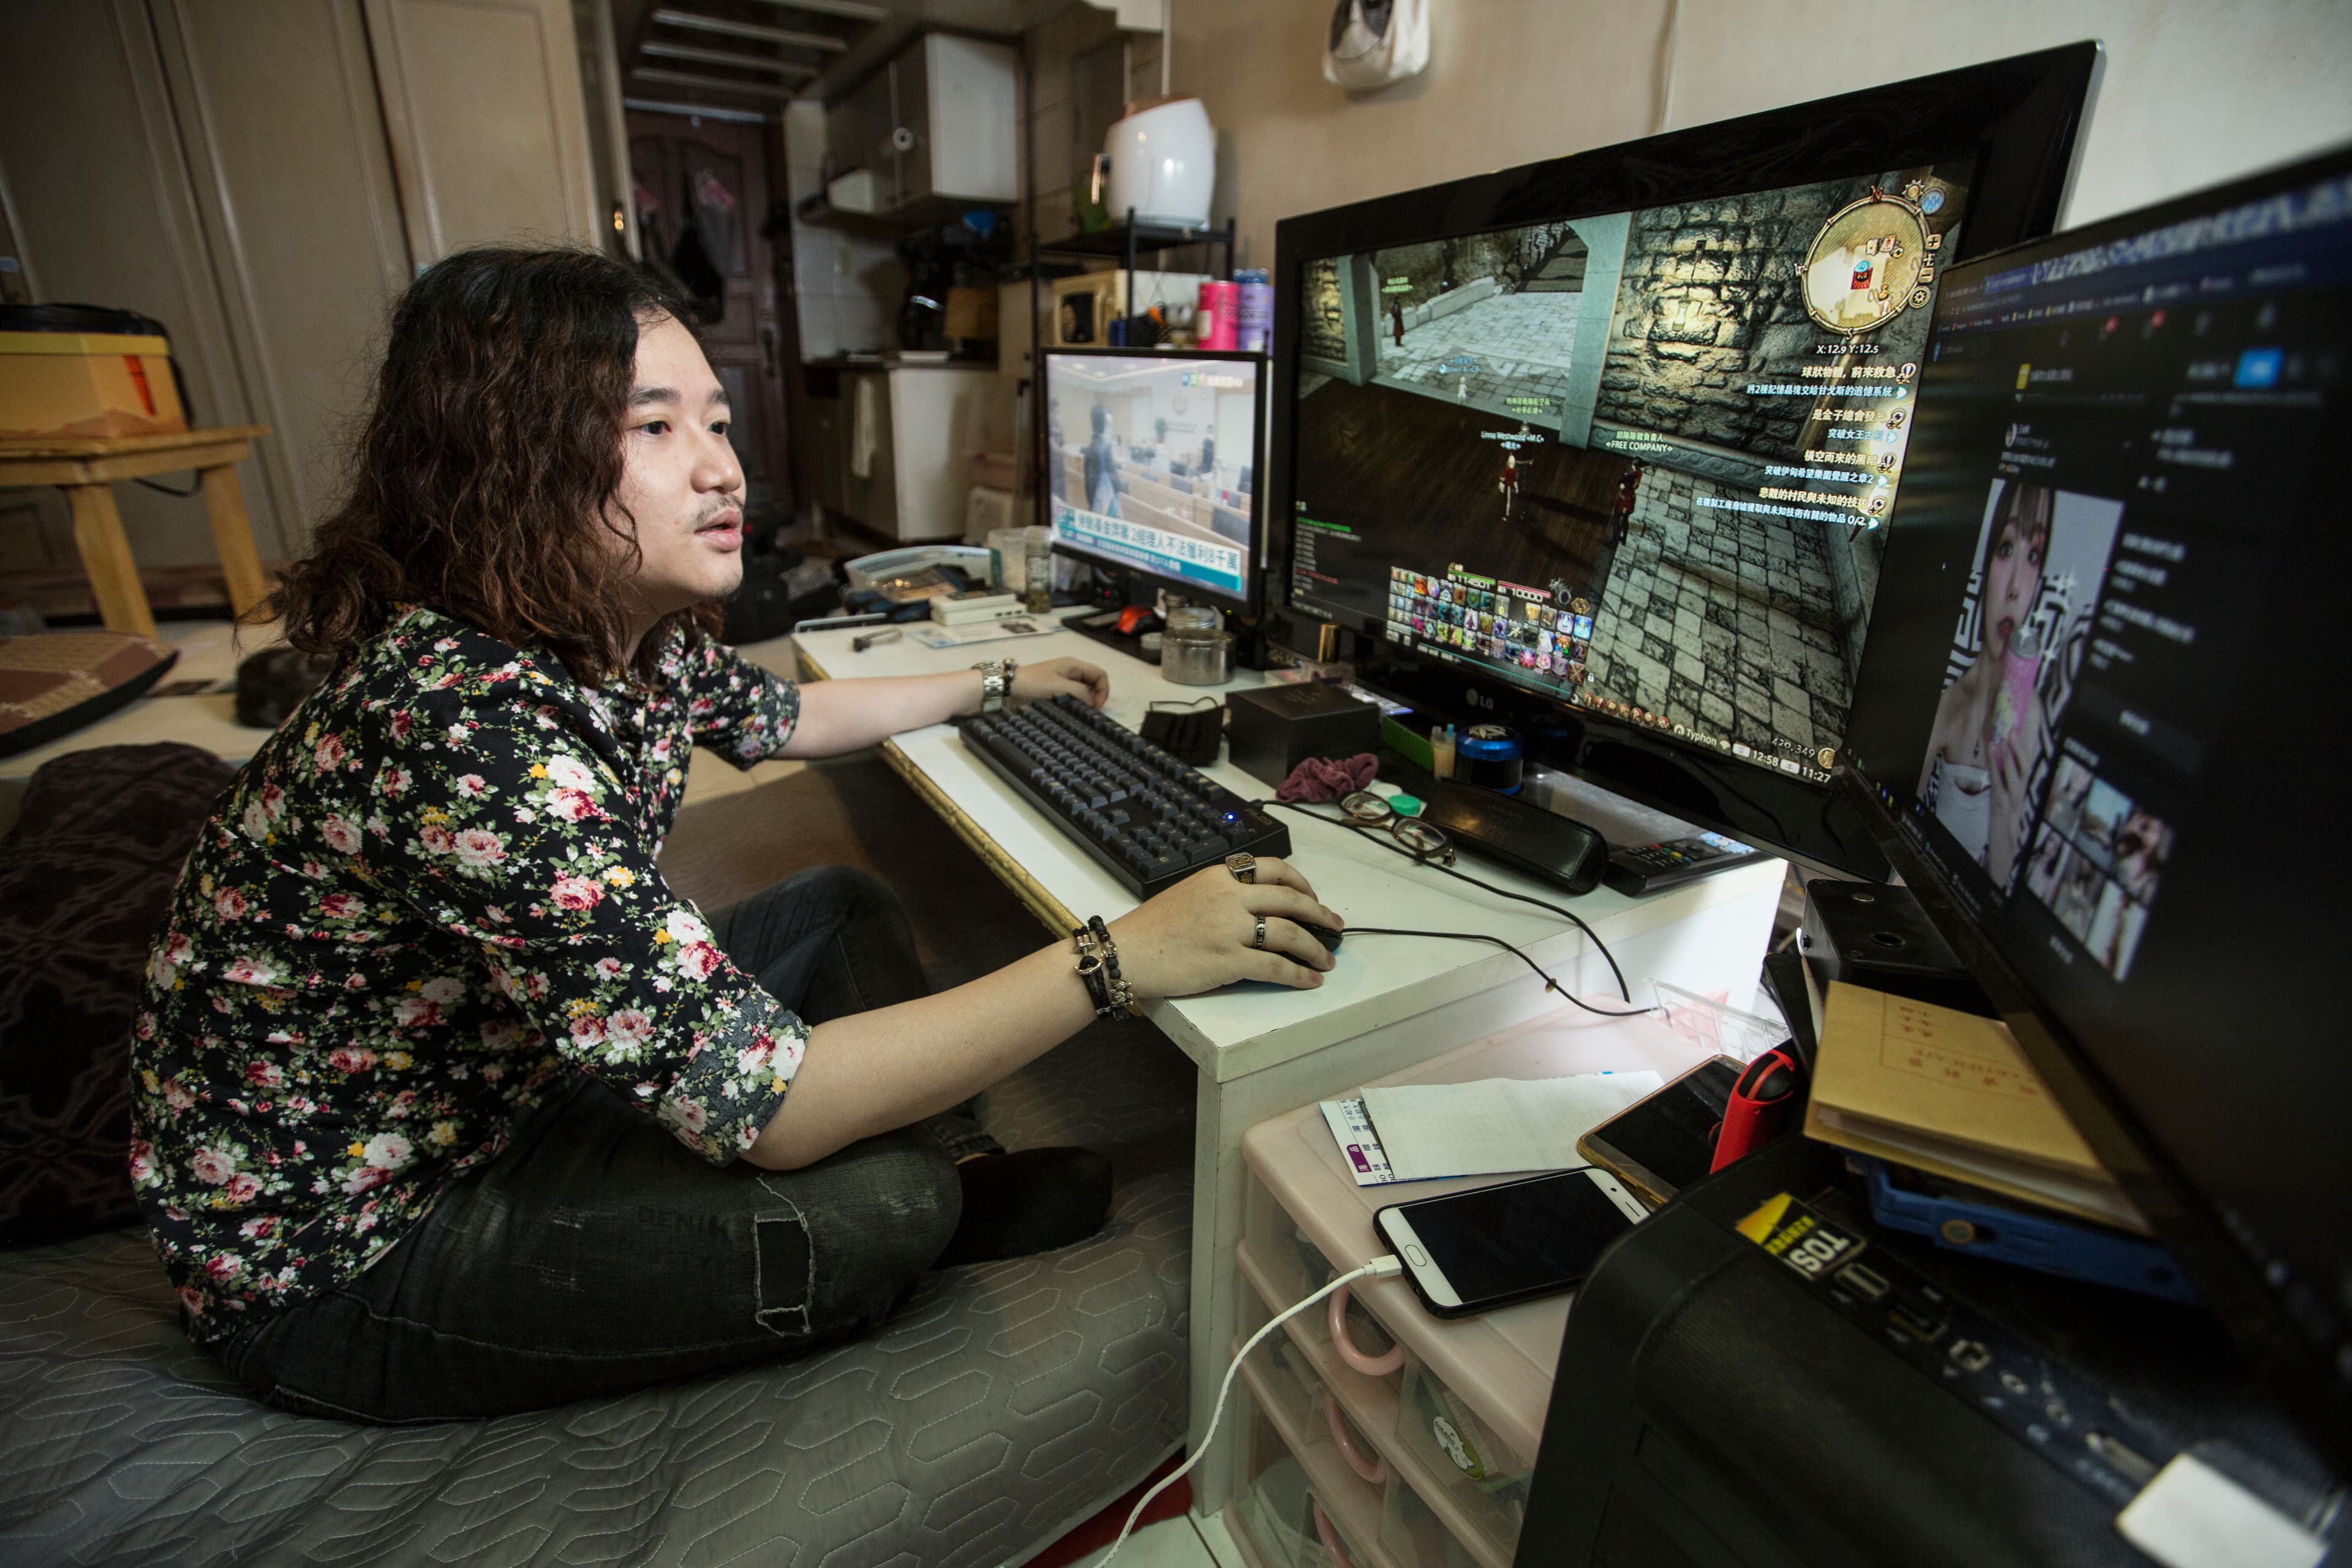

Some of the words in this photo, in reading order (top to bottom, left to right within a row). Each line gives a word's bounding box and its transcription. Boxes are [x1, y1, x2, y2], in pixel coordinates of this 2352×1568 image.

[1816, 345, 1847, 355] X:12.9
[1849, 344, 1879, 353] Y:12.5
[1611, 440, 1627, 450] FREE
[1629, 441, 1667, 452] COMPANY
[1480, 695, 1494, 710] LG
[1686, 727, 1717, 747] Typhon
[1752, 750, 1779, 767] 12:58
[1802, 766, 1831, 784] 11:27
[1783, 1229, 1850, 1279] TOS
